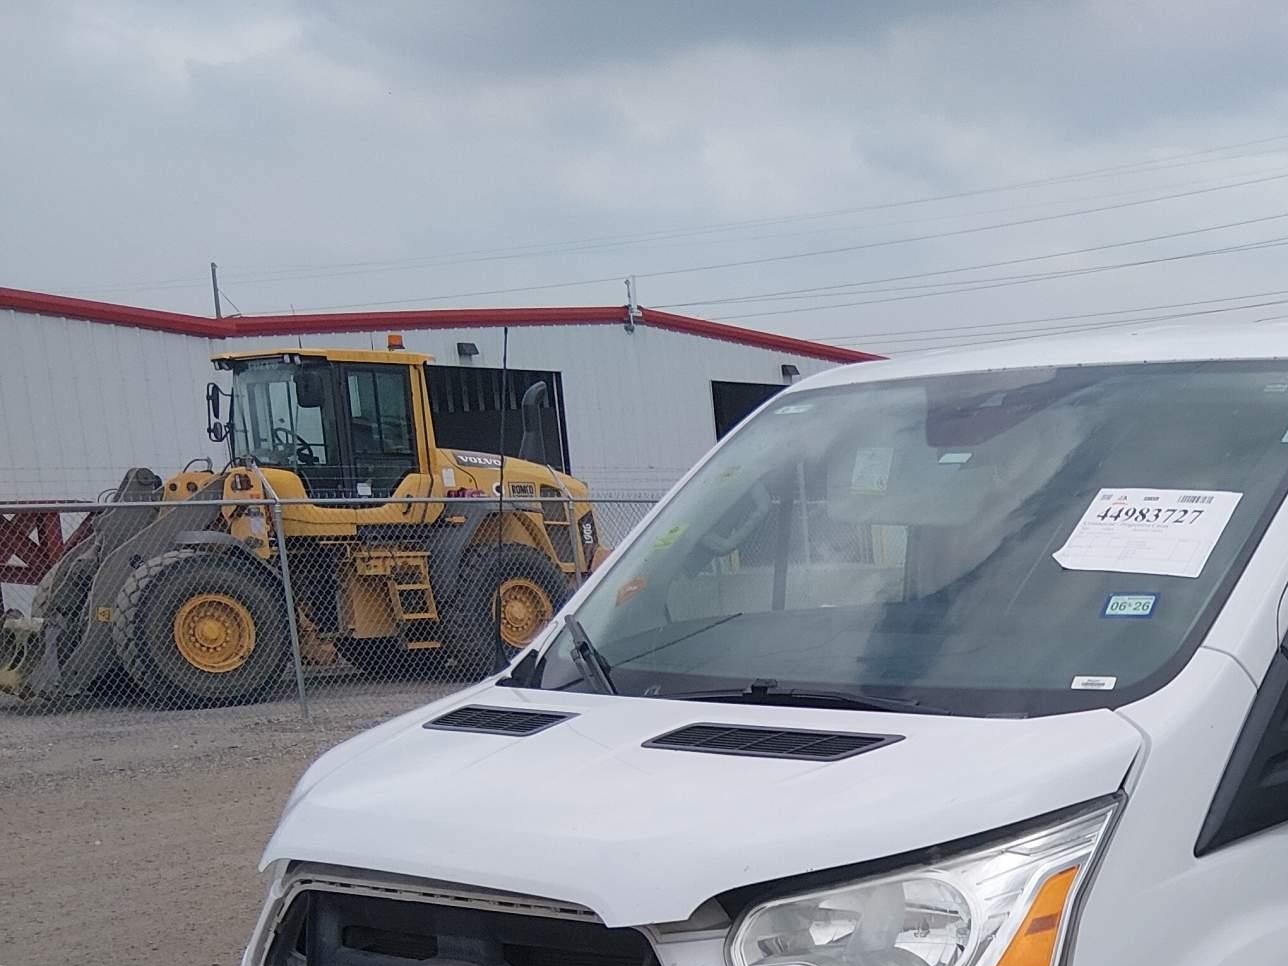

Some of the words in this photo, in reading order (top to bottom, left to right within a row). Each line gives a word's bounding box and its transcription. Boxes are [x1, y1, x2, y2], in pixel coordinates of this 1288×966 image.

[457, 455, 502, 466] VOLVO
[1097, 506, 1205, 525] 44983727
[1110, 601, 1127, 612] 06
[1133, 601, 1152, 612] 26
